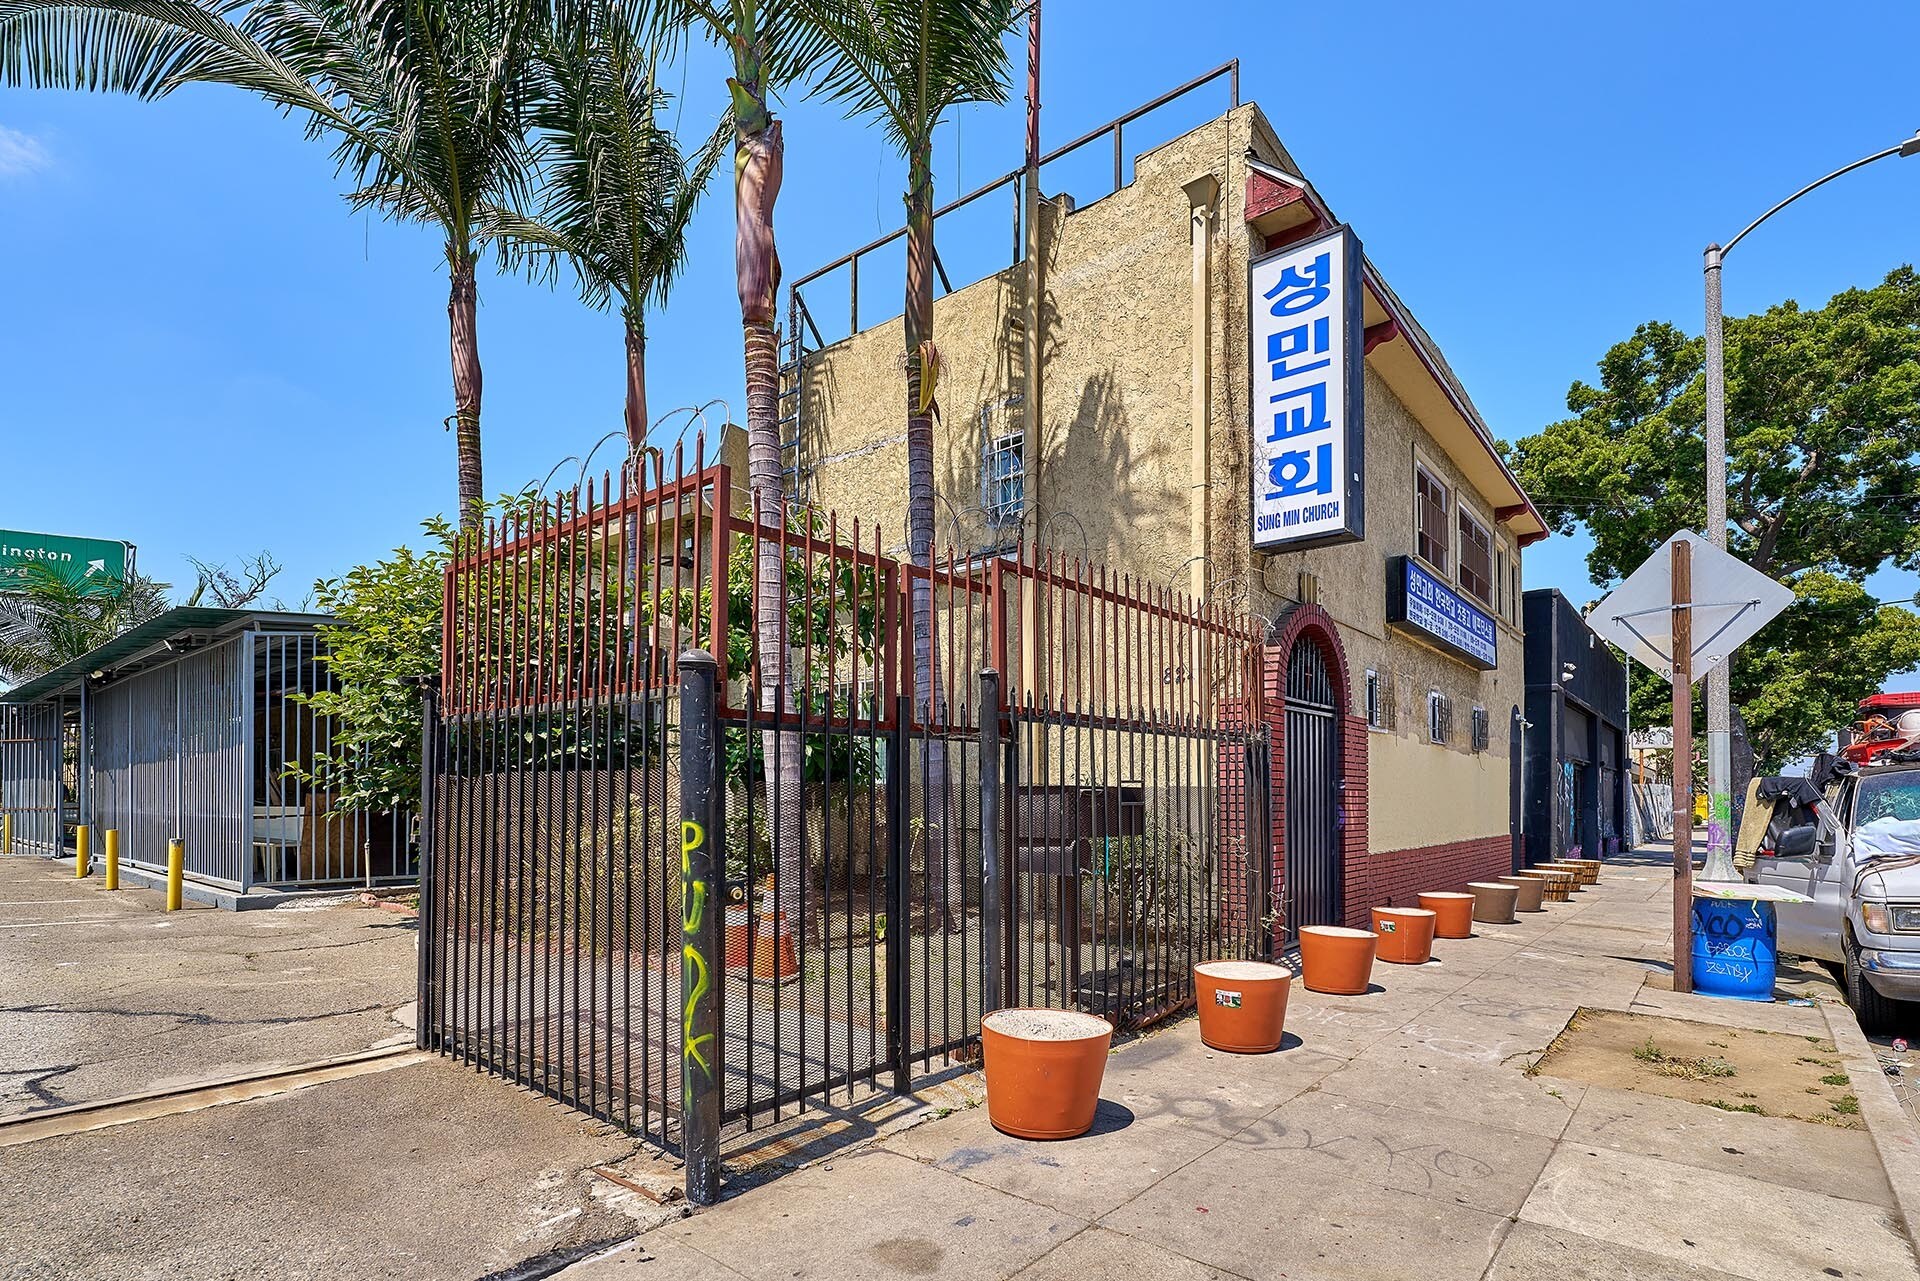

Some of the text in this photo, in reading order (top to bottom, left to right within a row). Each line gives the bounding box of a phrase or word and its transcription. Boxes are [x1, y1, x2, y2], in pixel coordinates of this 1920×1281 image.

[1262, 252, 1333, 501] 성민교회
[1257, 500, 1339, 532] SUNG MIN CHURCH
[1409, 569, 1434, 605] 성민교회
[1435, 587, 1456, 619] 한국학교
